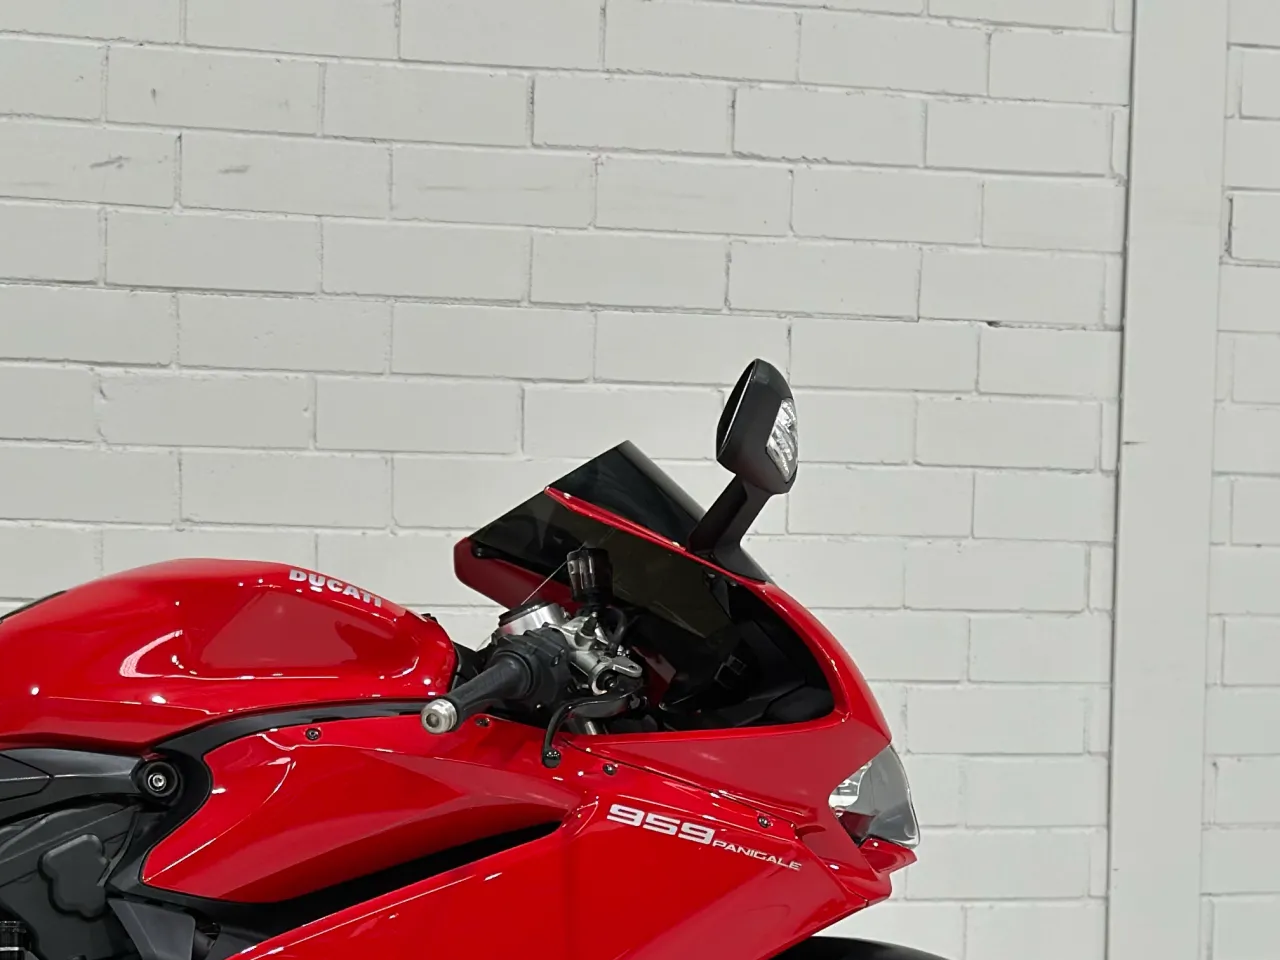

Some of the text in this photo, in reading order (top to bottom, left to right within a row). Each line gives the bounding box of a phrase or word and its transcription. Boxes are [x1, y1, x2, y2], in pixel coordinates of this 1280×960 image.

[289, 569, 382, 608] DUCATI
[606, 803, 803, 871] 959 PANIGALE
